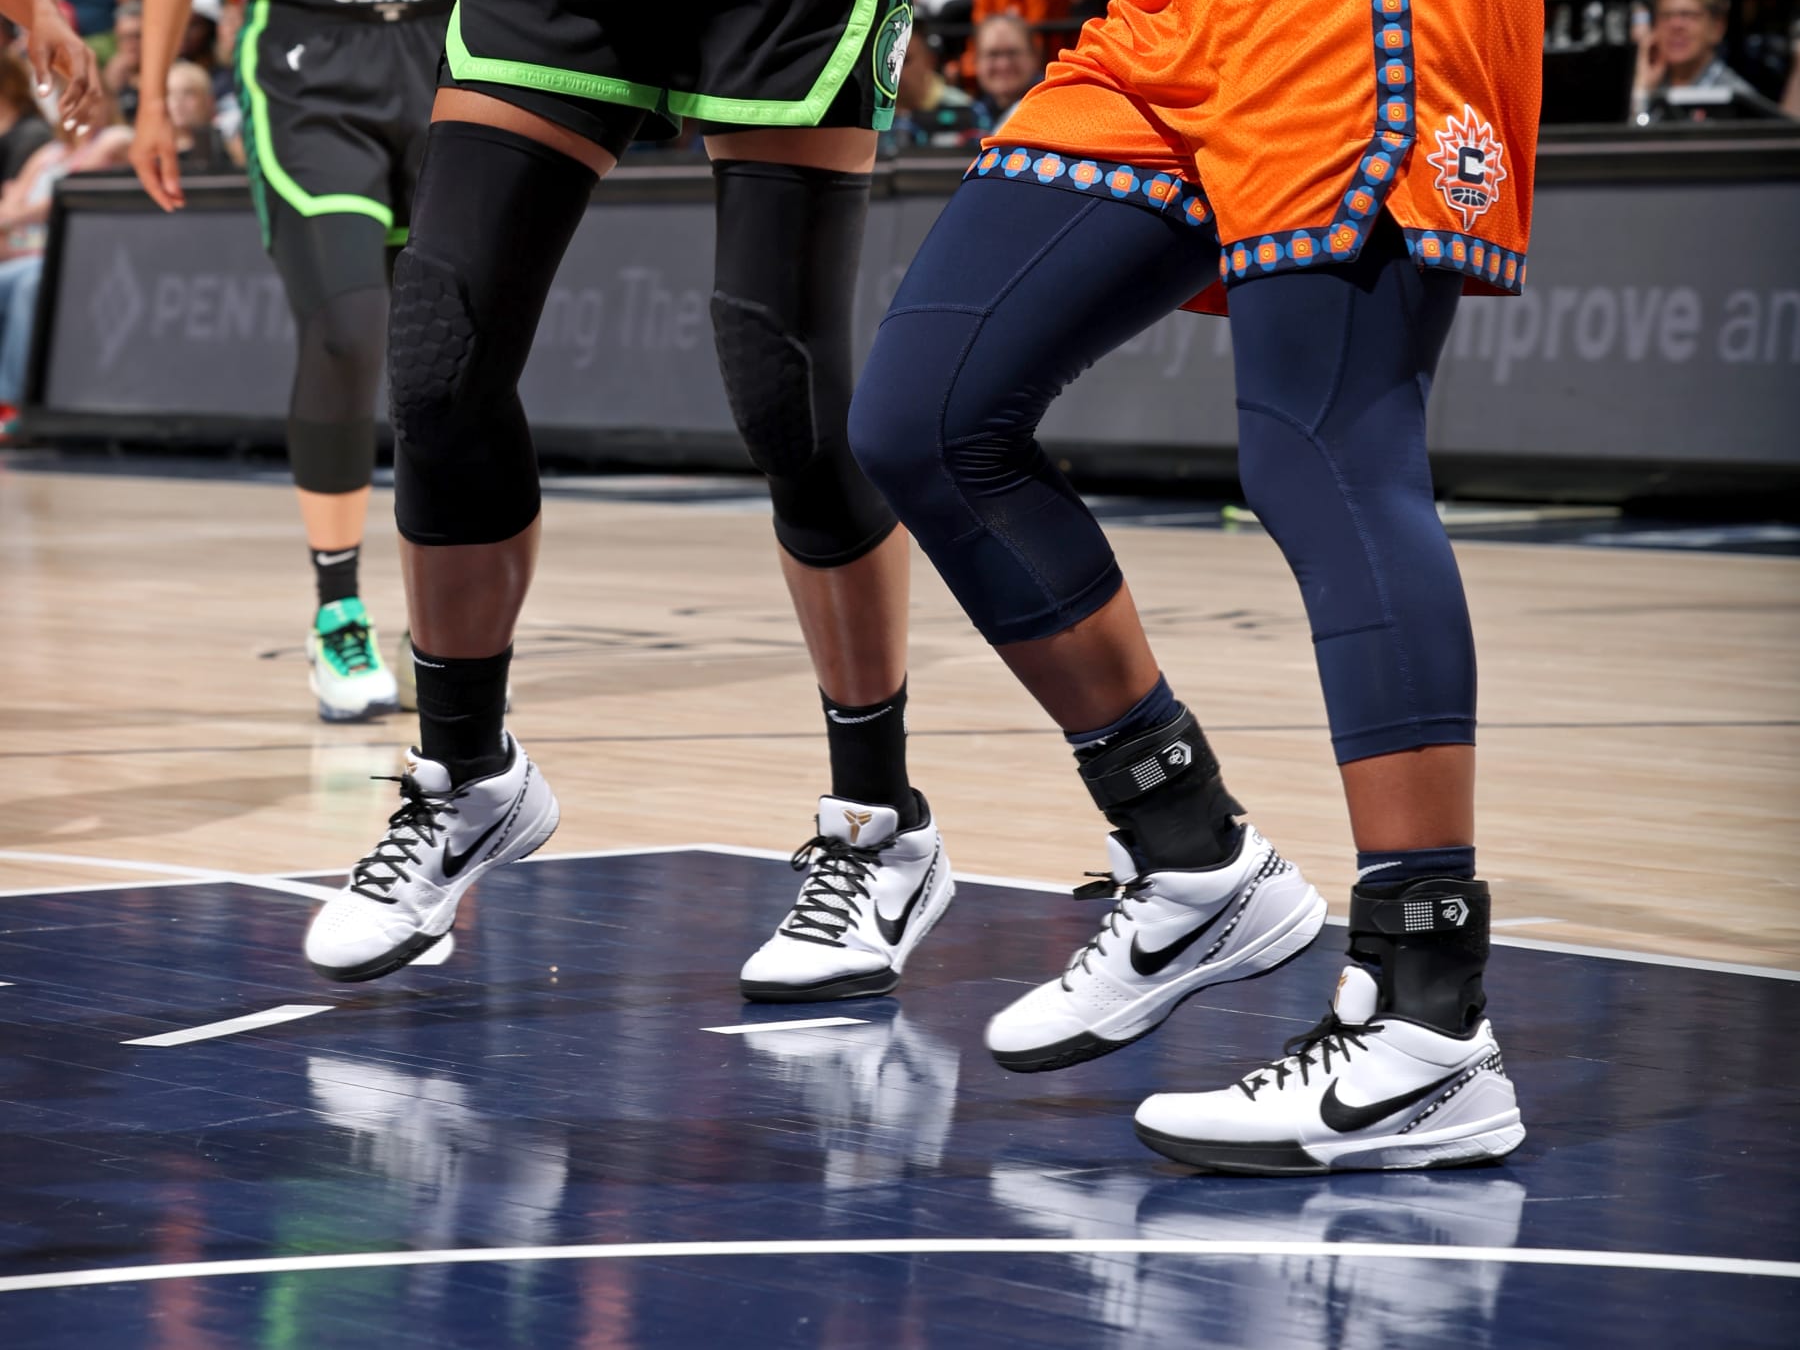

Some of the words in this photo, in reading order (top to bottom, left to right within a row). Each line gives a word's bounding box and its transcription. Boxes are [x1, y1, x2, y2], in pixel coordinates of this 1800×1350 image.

[150, 272, 294, 342] PENT
[617, 265, 705, 351] The
[1452, 287, 1701, 386] mprove
